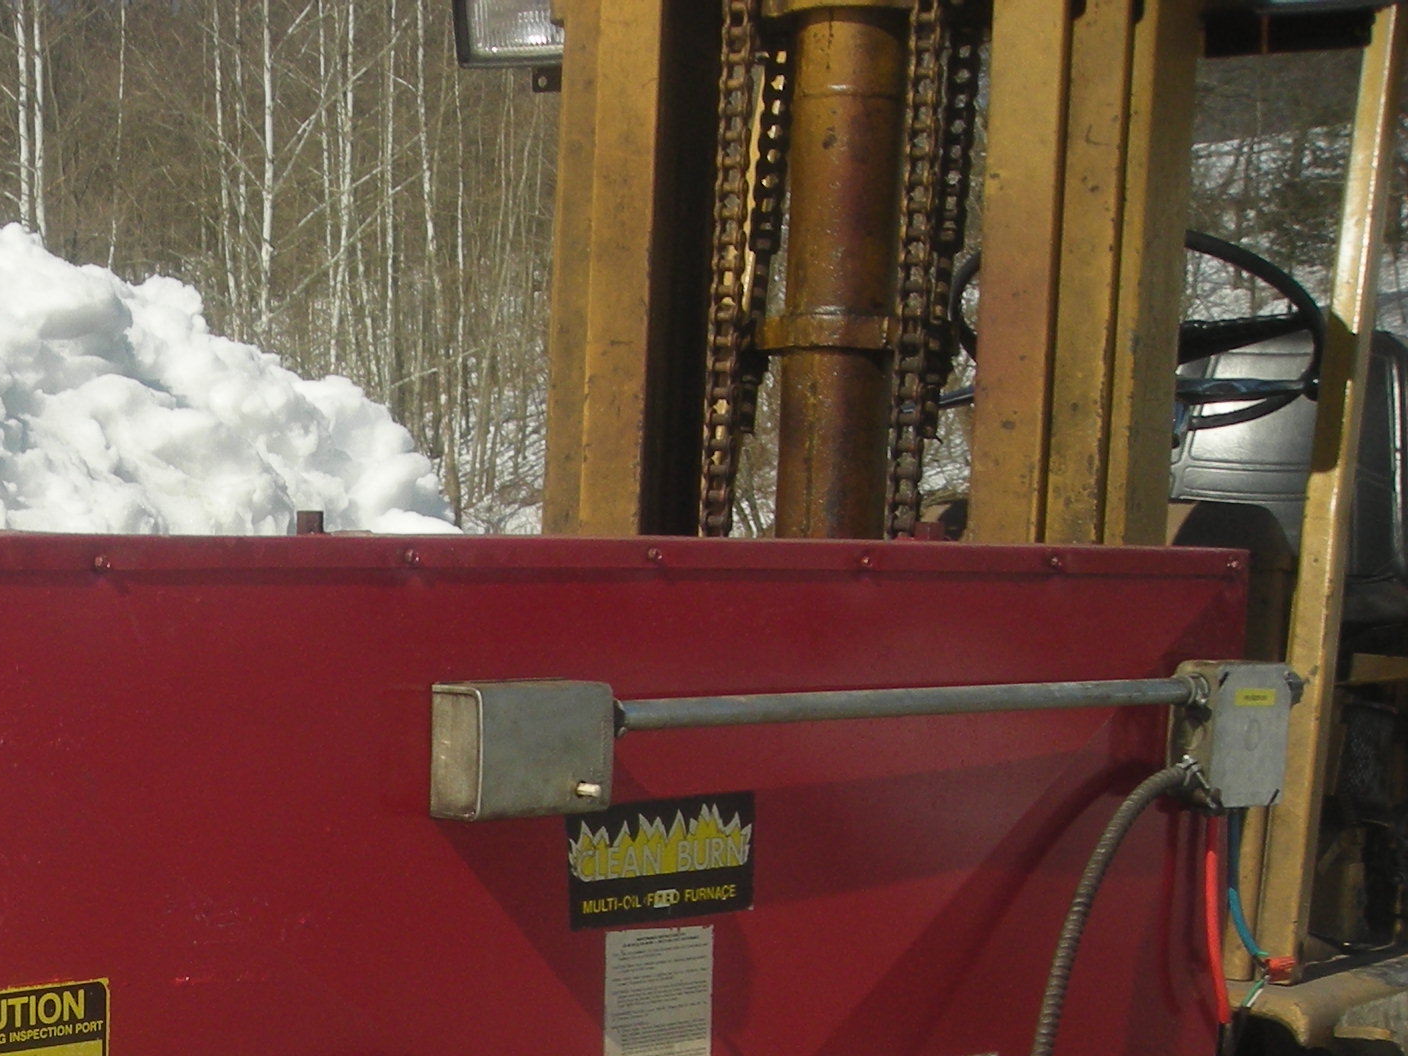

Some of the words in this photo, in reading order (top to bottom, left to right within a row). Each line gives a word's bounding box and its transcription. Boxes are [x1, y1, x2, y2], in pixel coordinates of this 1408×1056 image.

[577, 842, 662, 882] CLEAN
[678, 837, 745, 873] BURN
[582, 896, 642, 914] MULTI-OIL
[684, 884, 737, 902] FURNACE
[9, 1024, 73, 1043] INSPECTION
[75, 1020, 104, 1035] PORT
